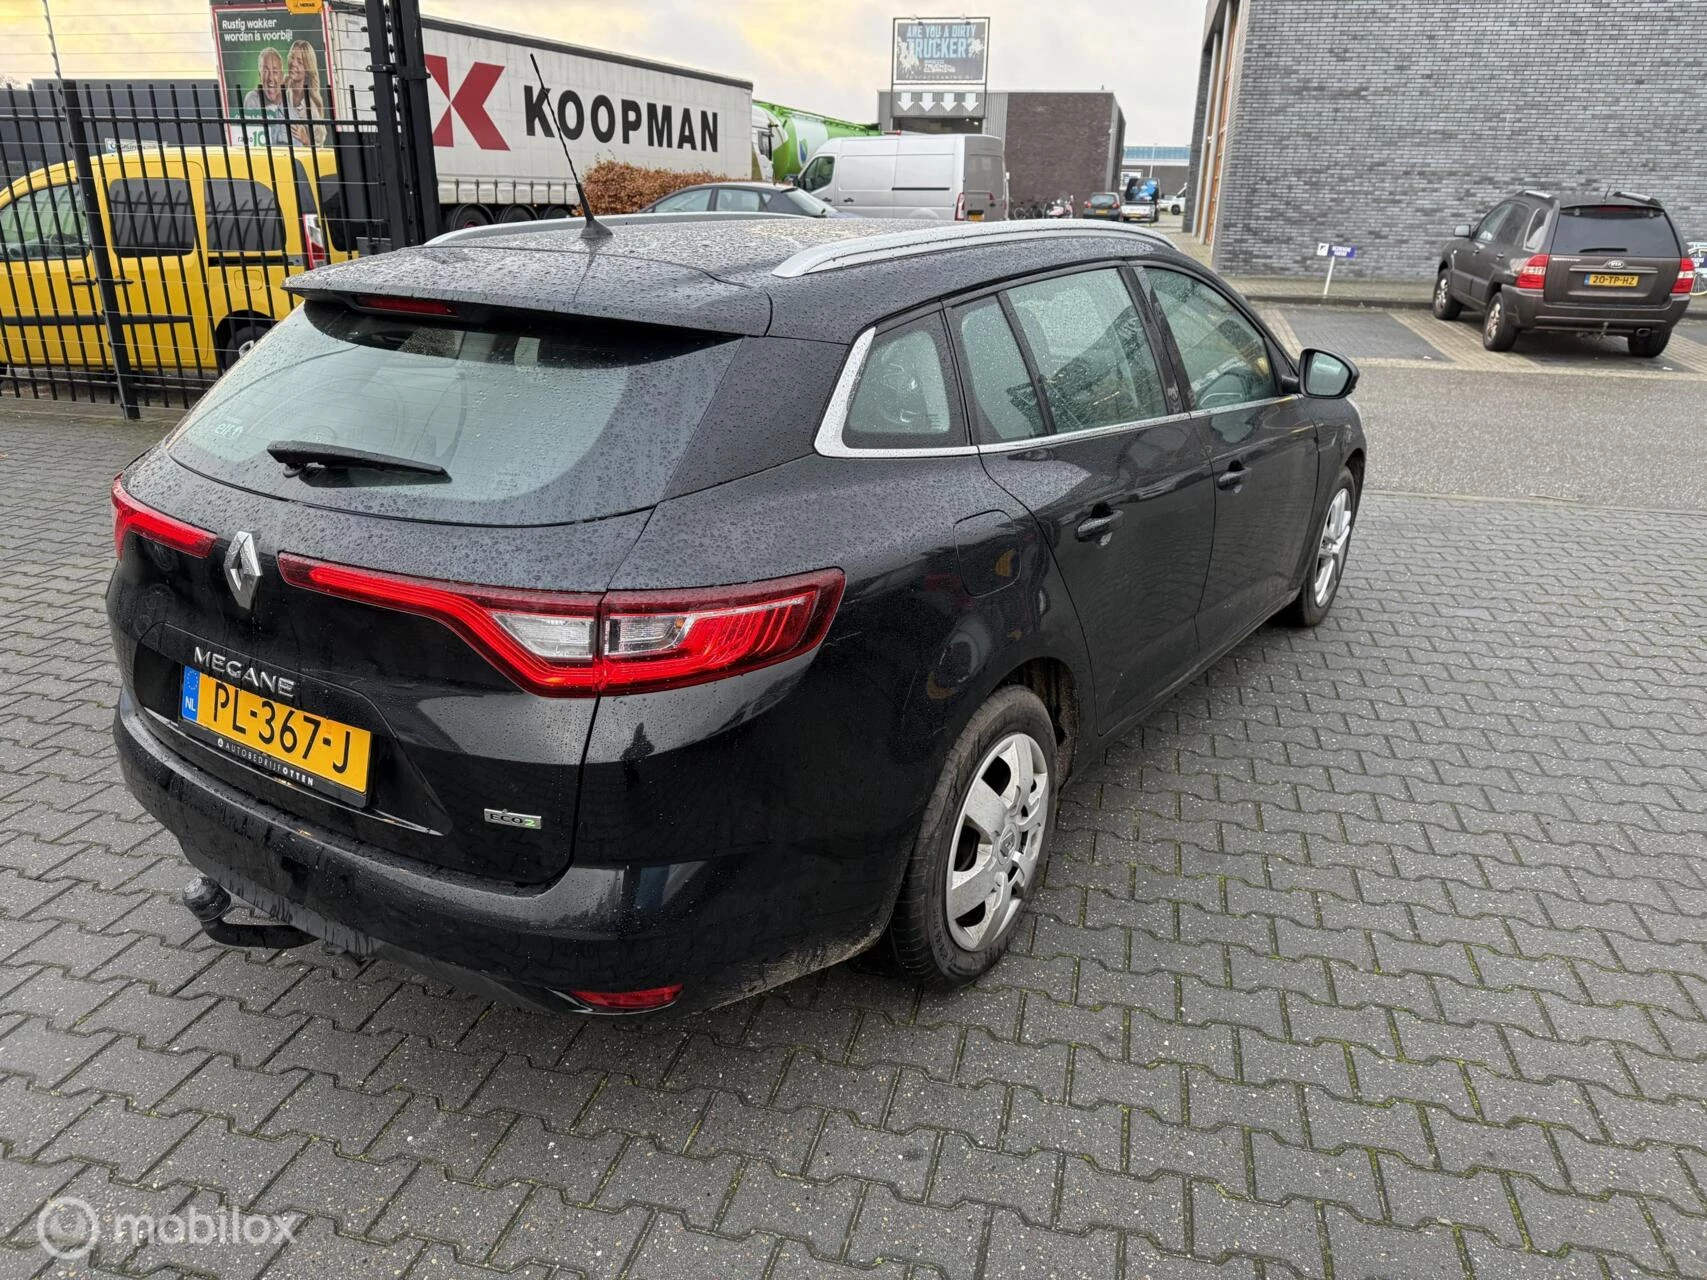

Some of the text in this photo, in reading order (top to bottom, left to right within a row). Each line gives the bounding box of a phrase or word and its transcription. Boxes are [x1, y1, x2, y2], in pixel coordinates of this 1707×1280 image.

[222, 18, 277, 30] Rustig wakker
[224, 29, 293, 42] worden is voorbij!
[907, 25, 976, 37] ARE YOU A DIRTY
[523, 84, 719, 152] KOOPMAN
[1592, 275, 1635, 285] 20-TP-HZ
[194, 646, 295, 697] MEGANE
[185, 681, 351, 774] NL PL-367-J
[490, 813, 537, 827] ECO2
